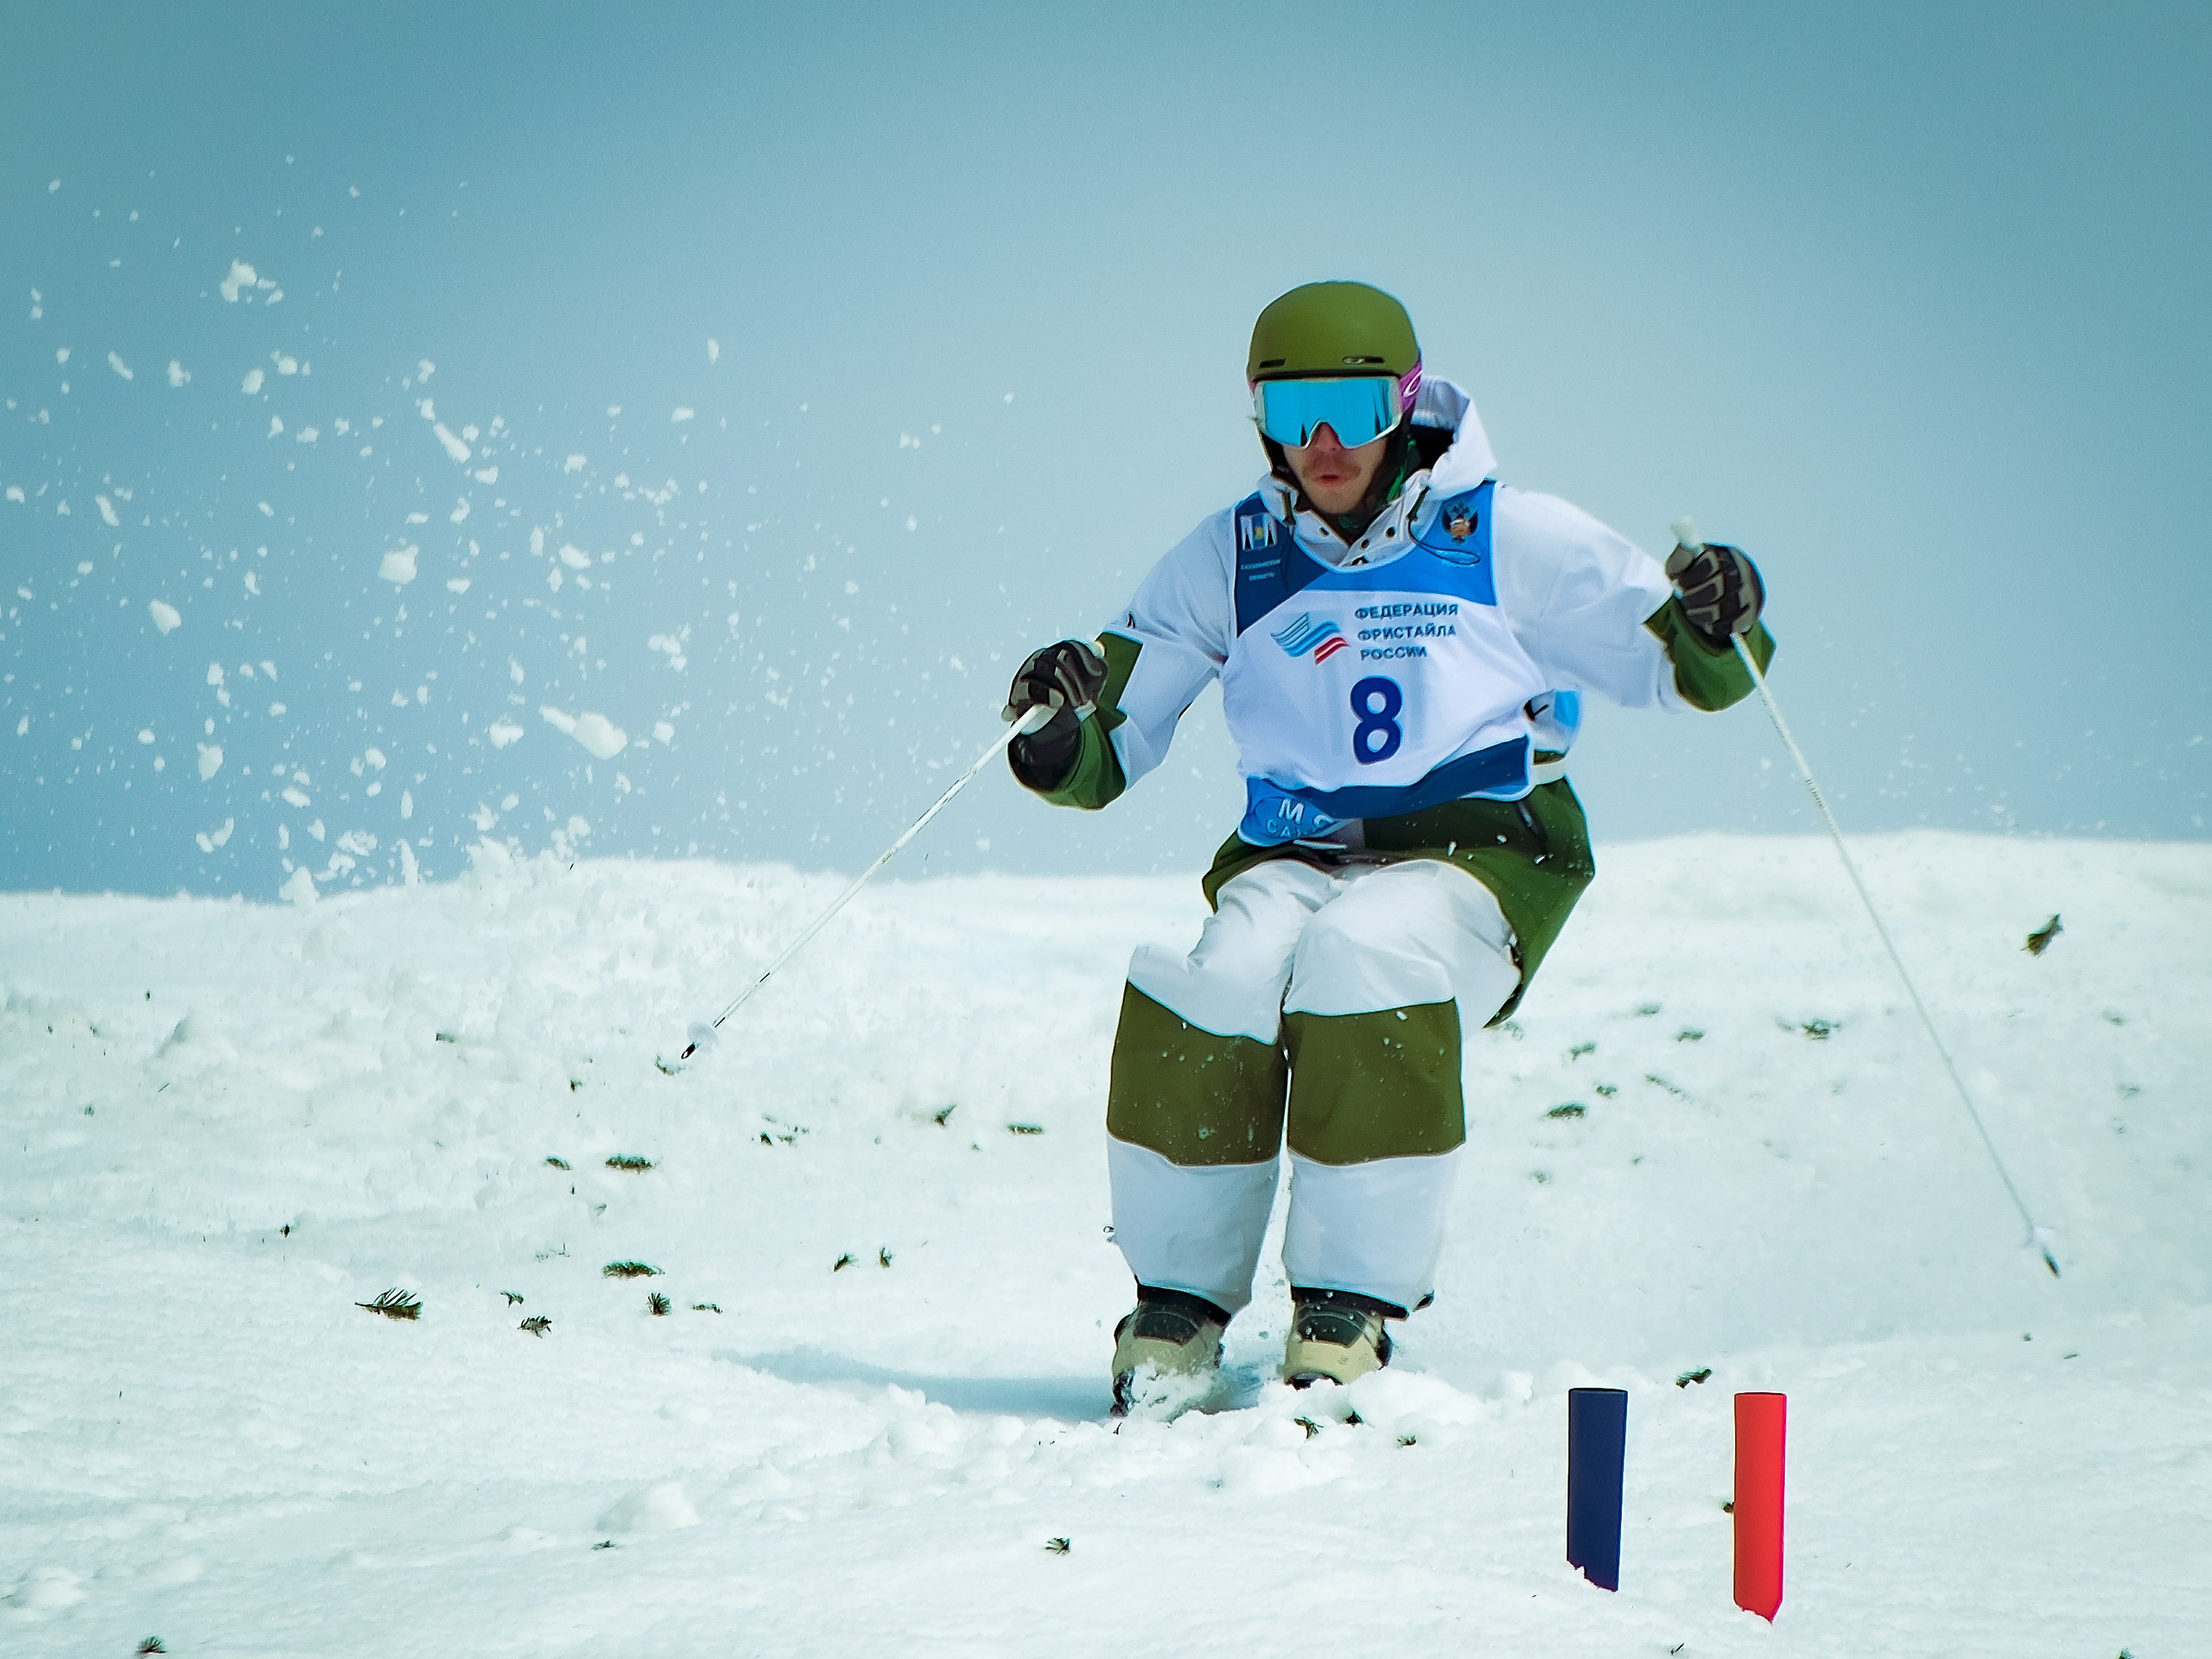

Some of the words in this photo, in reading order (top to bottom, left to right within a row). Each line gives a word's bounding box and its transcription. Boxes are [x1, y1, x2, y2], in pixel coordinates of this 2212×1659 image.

[1354, 604, 1459, 620] ФЕДЕРАЦИЯ
[1357, 622, 1457, 640] ФРИСТАЙЛА
[1360, 646, 1427, 661] РОССИИ
[1350, 676, 1403, 766] 8
